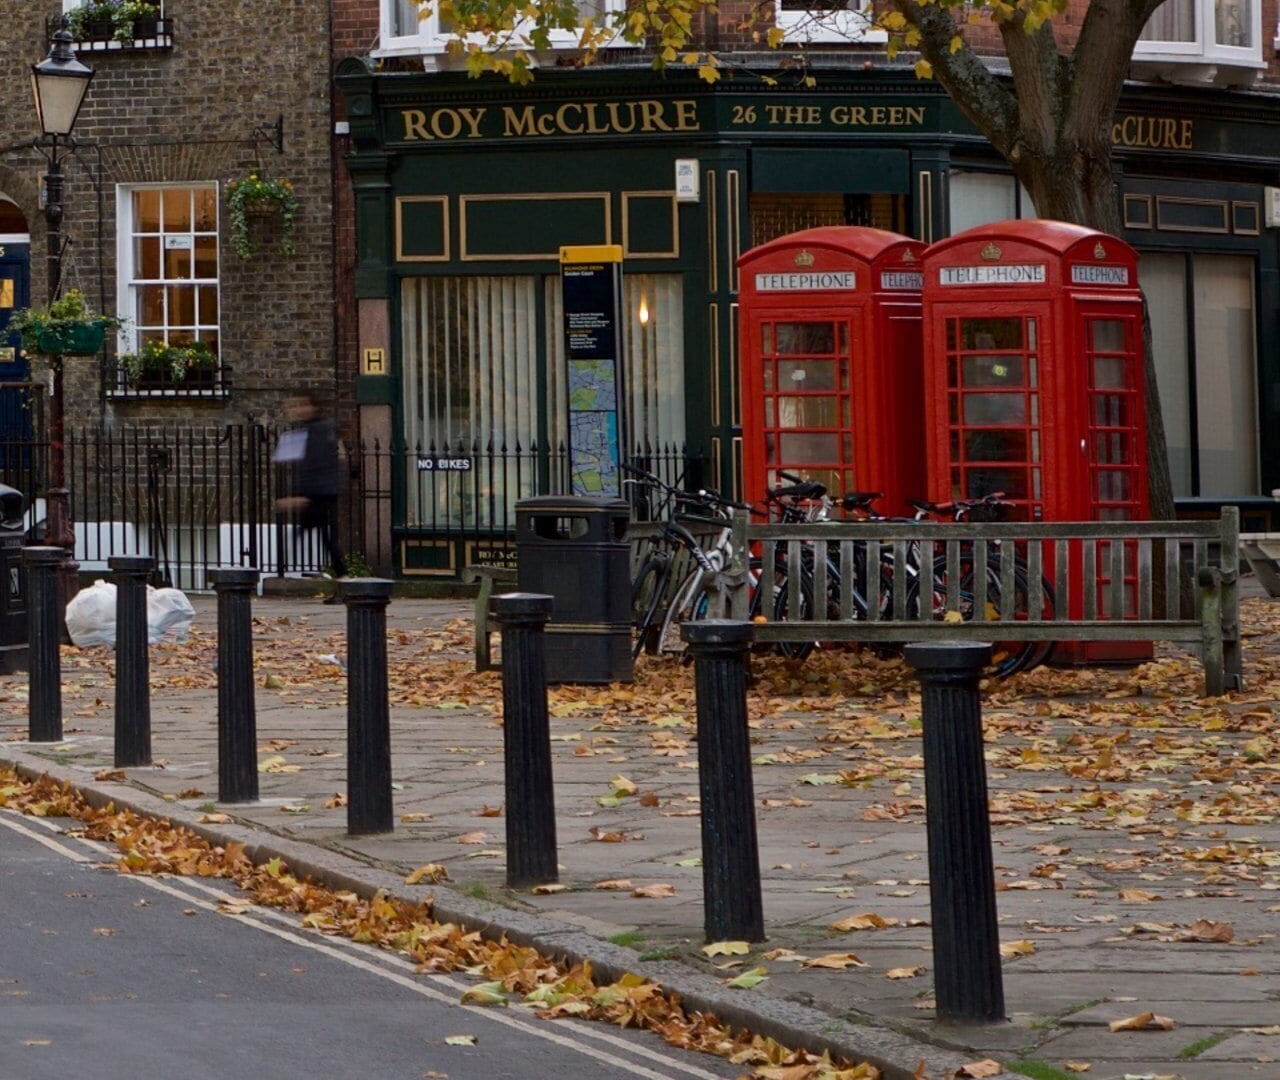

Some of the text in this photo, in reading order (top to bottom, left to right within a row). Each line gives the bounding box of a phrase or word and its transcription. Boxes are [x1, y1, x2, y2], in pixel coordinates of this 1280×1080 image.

[401, 100, 701, 140] ROY McCLURE
[731, 105, 926, 125] 26 THE GREEN
[1111, 115, 1193, 149] cCLURE
[760, 273, 853, 289] TELEPHONE
[883, 273, 924, 288] TELEPHO
[945, 266, 1043, 283] TELEPHONE
[1073, 266, 1126, 283] TELEPHONE
[367, 350, 382, 371] H
[418, 459, 470, 469] NO BIKES
